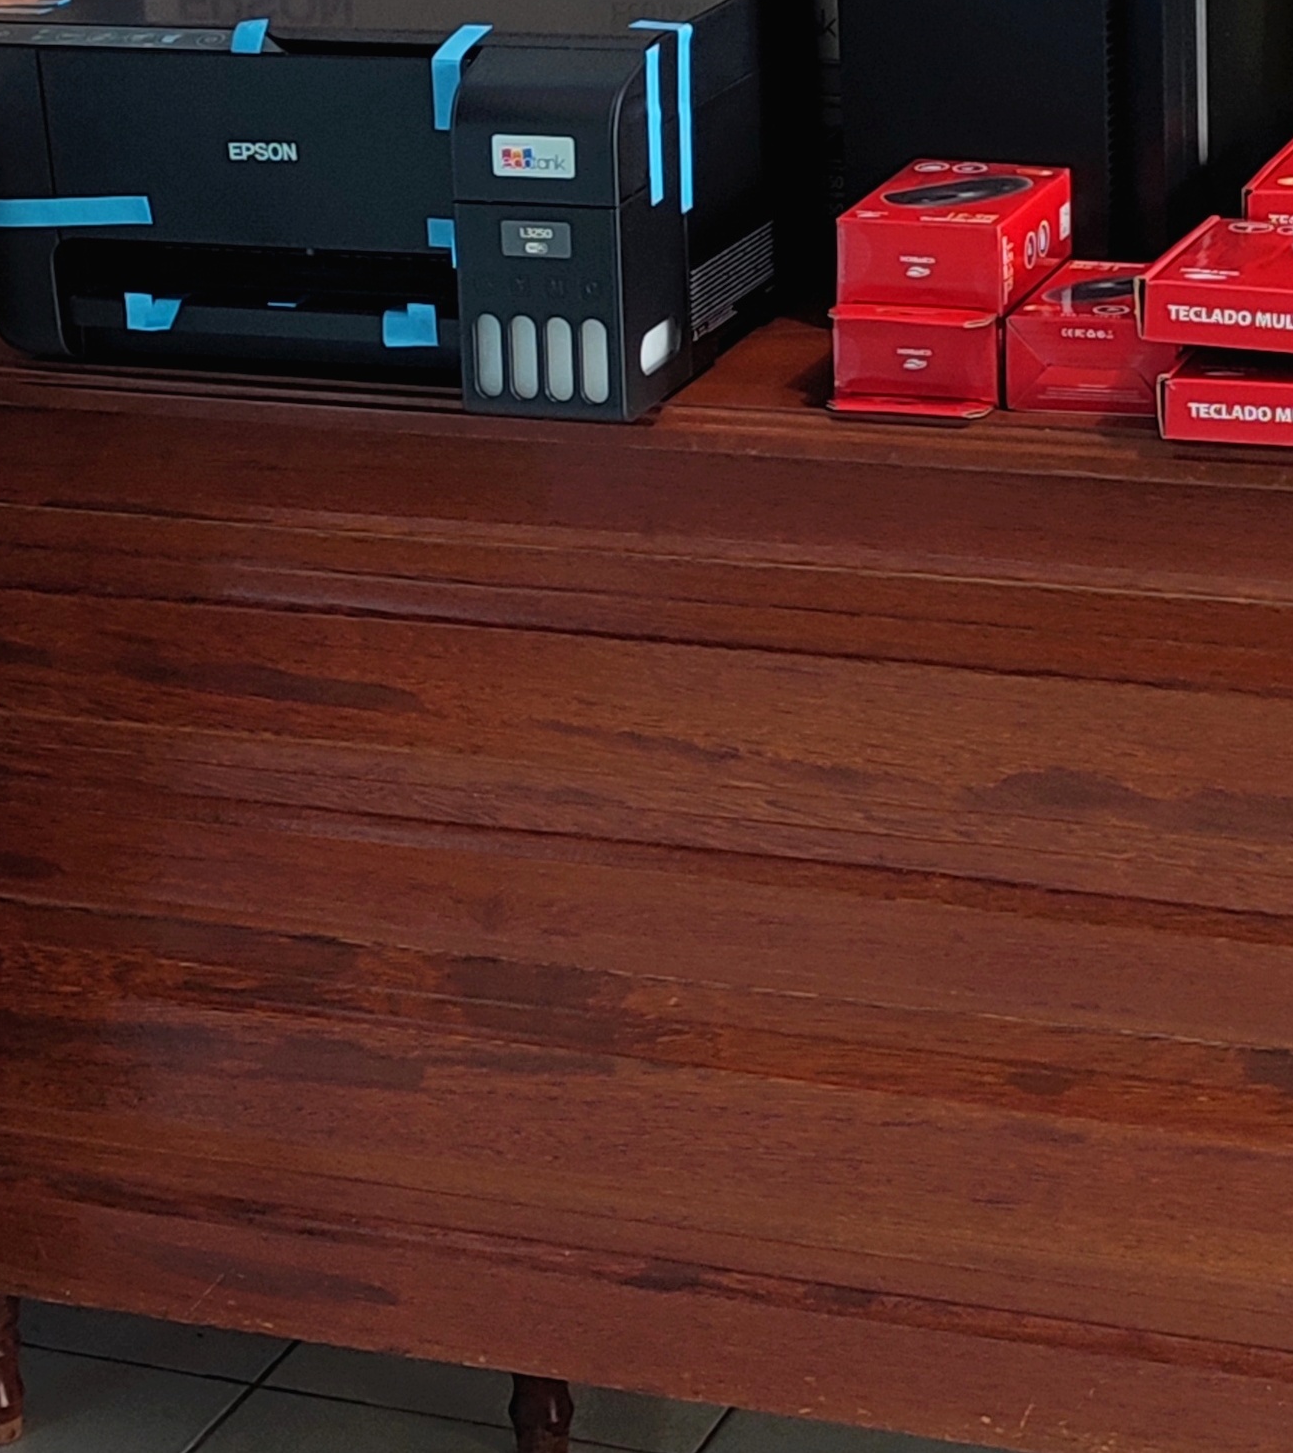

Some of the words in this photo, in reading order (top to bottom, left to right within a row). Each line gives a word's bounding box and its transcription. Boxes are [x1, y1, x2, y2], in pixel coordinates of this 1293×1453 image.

[227, 142, 299, 162] EPSON
[518, 226, 554, 240] L3250
[1166, 303, 1253, 327] TECLADO
[1186, 401, 1273, 423] TECLADO
